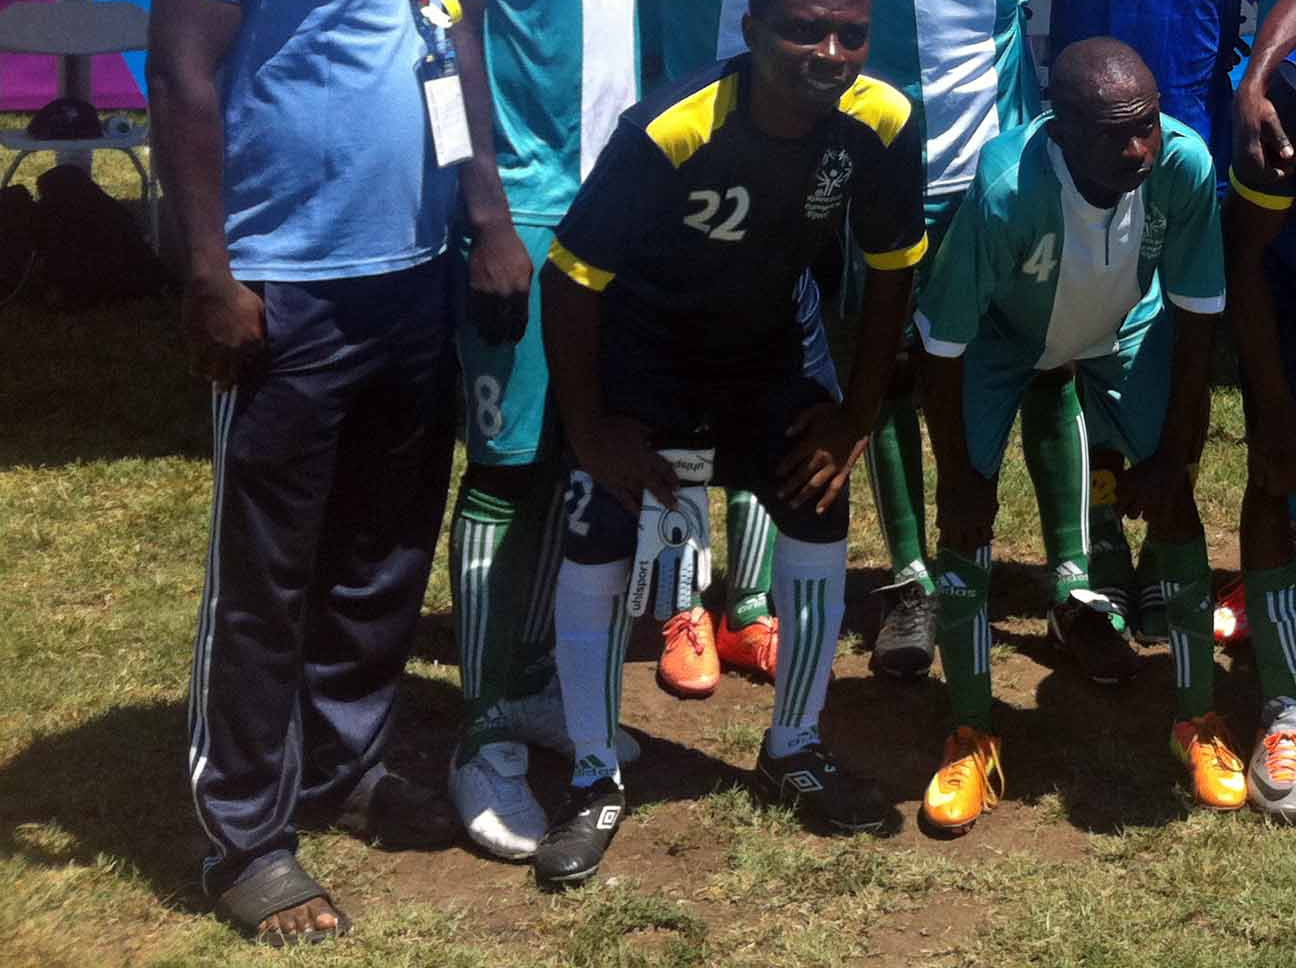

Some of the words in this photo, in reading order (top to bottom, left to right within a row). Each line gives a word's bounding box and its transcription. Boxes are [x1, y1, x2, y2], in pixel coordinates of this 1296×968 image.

[683, 186, 750, 241] 22
[1022, 232, 1059, 282] 4
[474, 375, 503, 437] 8
